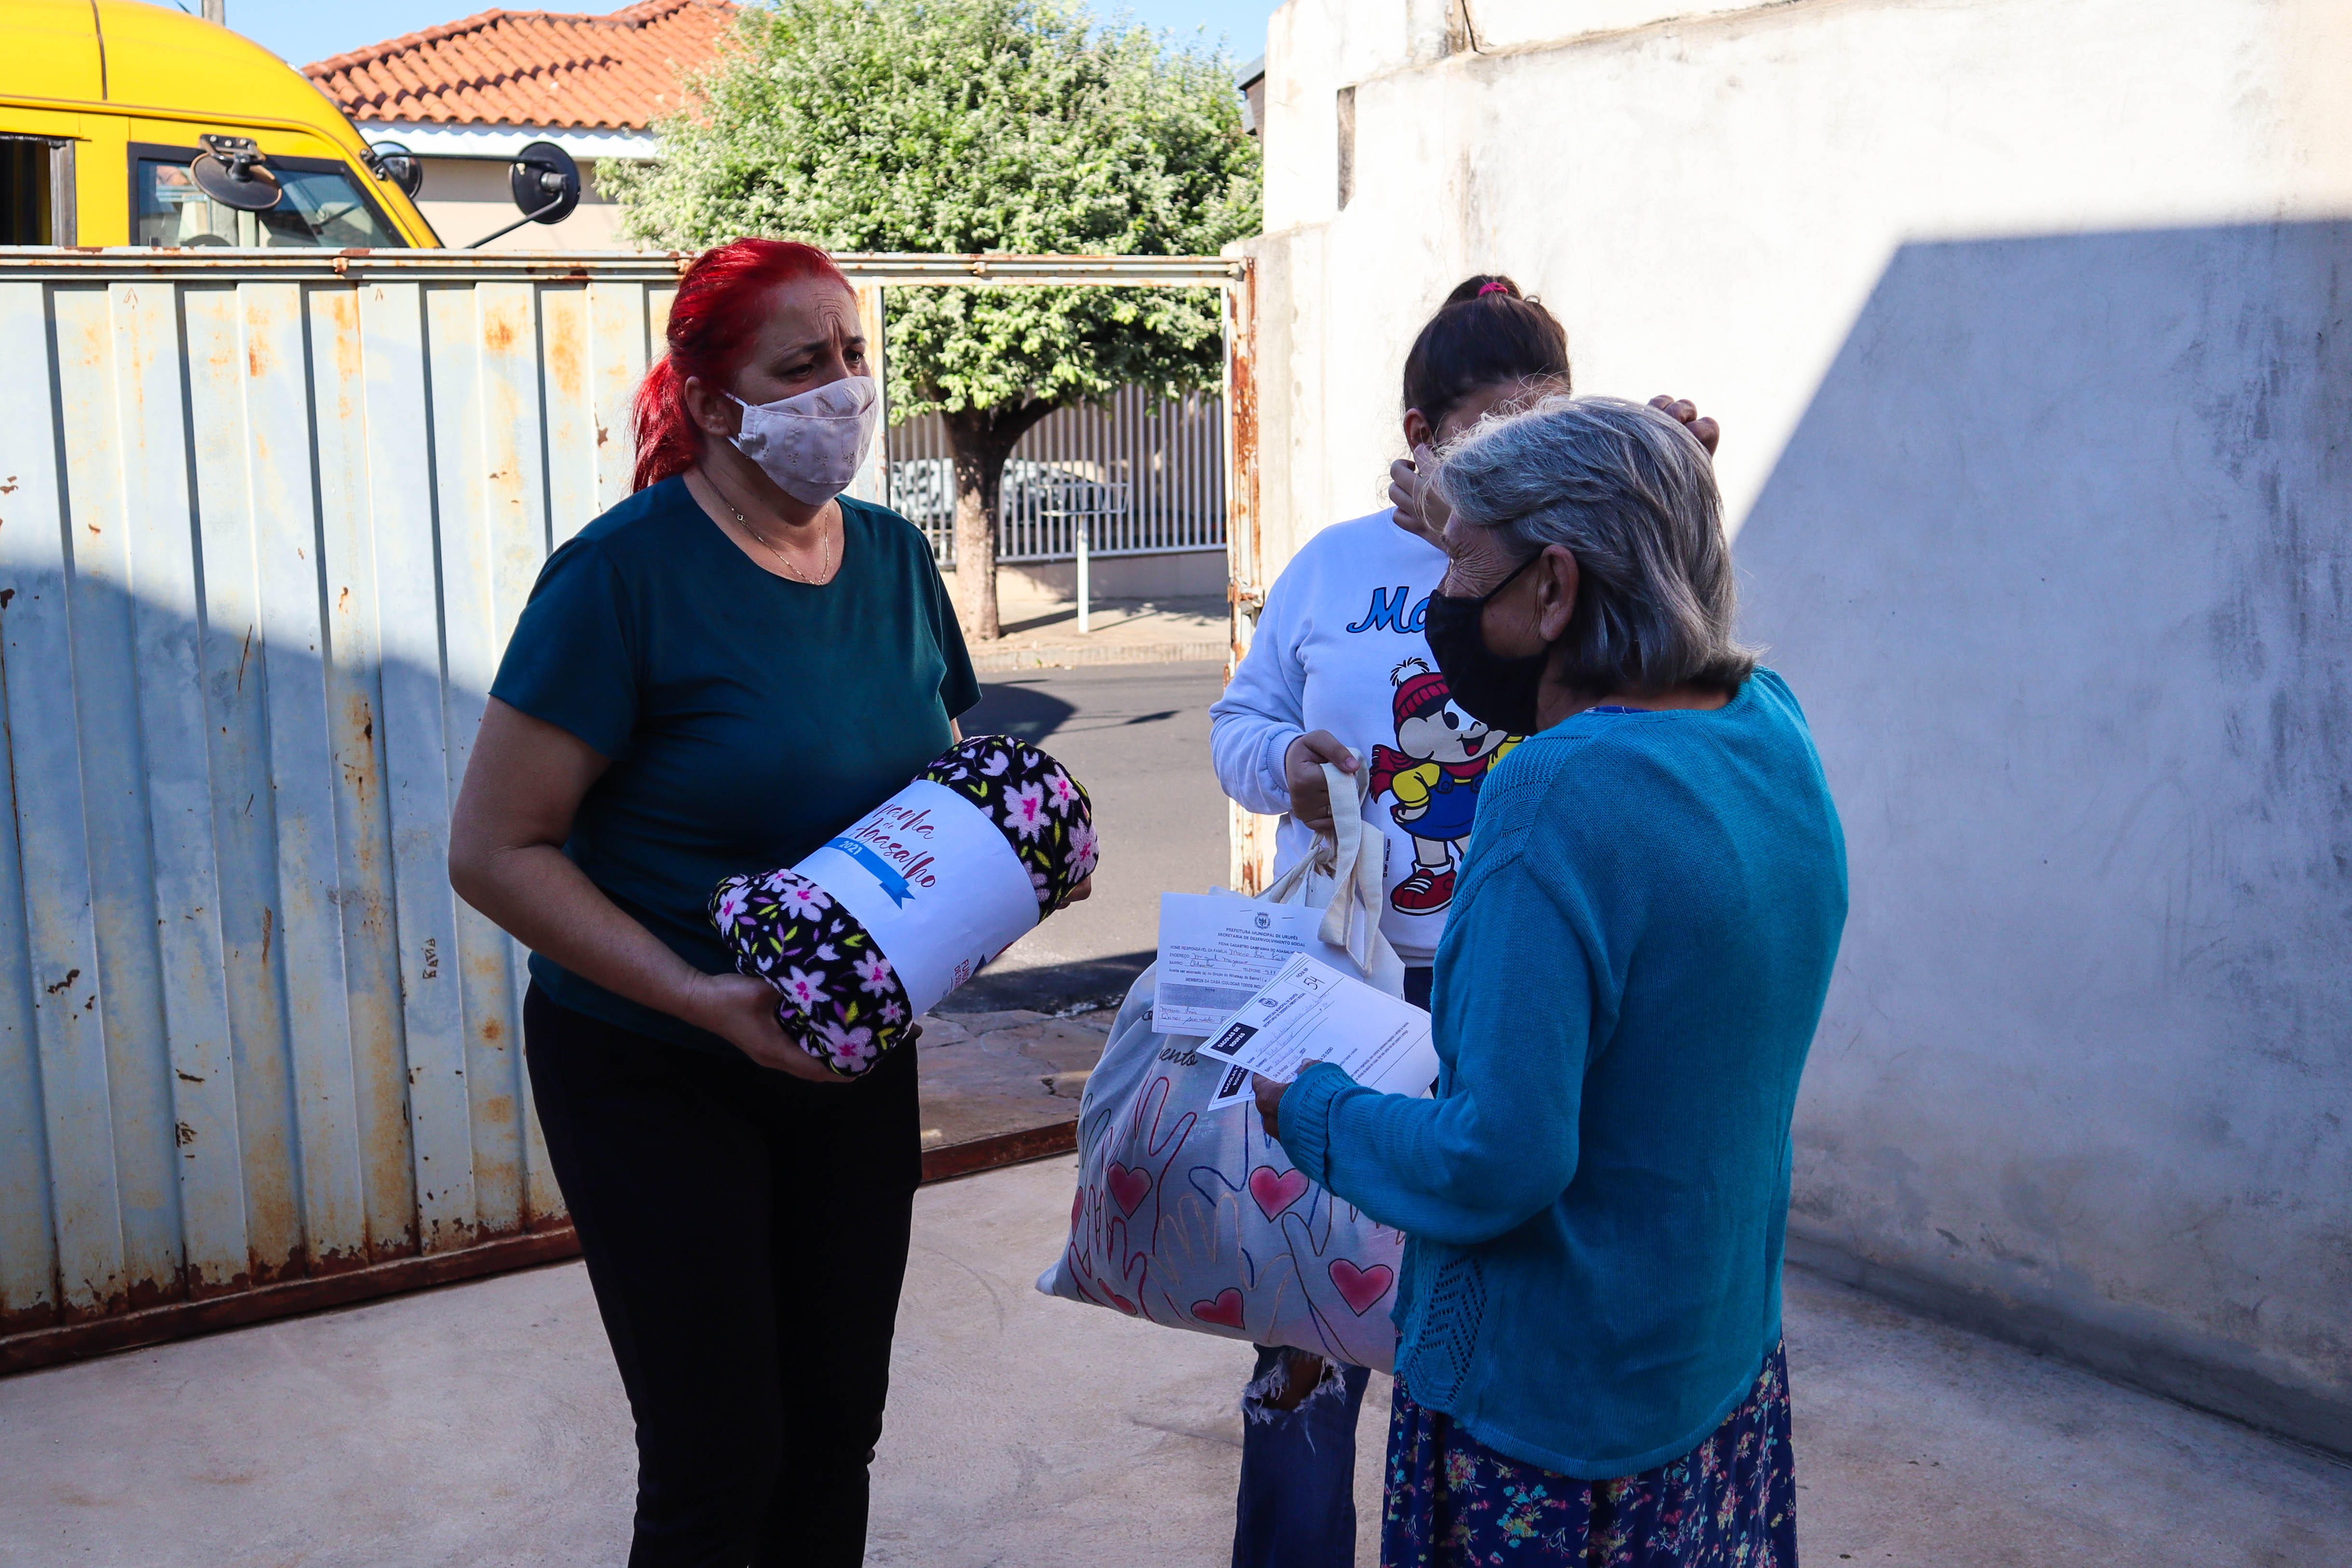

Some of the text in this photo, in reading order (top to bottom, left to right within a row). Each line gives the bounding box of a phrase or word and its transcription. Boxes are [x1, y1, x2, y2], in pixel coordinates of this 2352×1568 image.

[871, 804, 935, 839] panha
[838, 841, 863, 855] 2021
[849, 818, 936, 887] Agasalho
[1250, 936, 1291, 945] DESENVOLVIMENTO
[1303, 976, 1325, 990] 54
[1217, 1031, 1236, 1048] SACOLAS
[1229, 1033, 1246, 1047] ROUPAS
